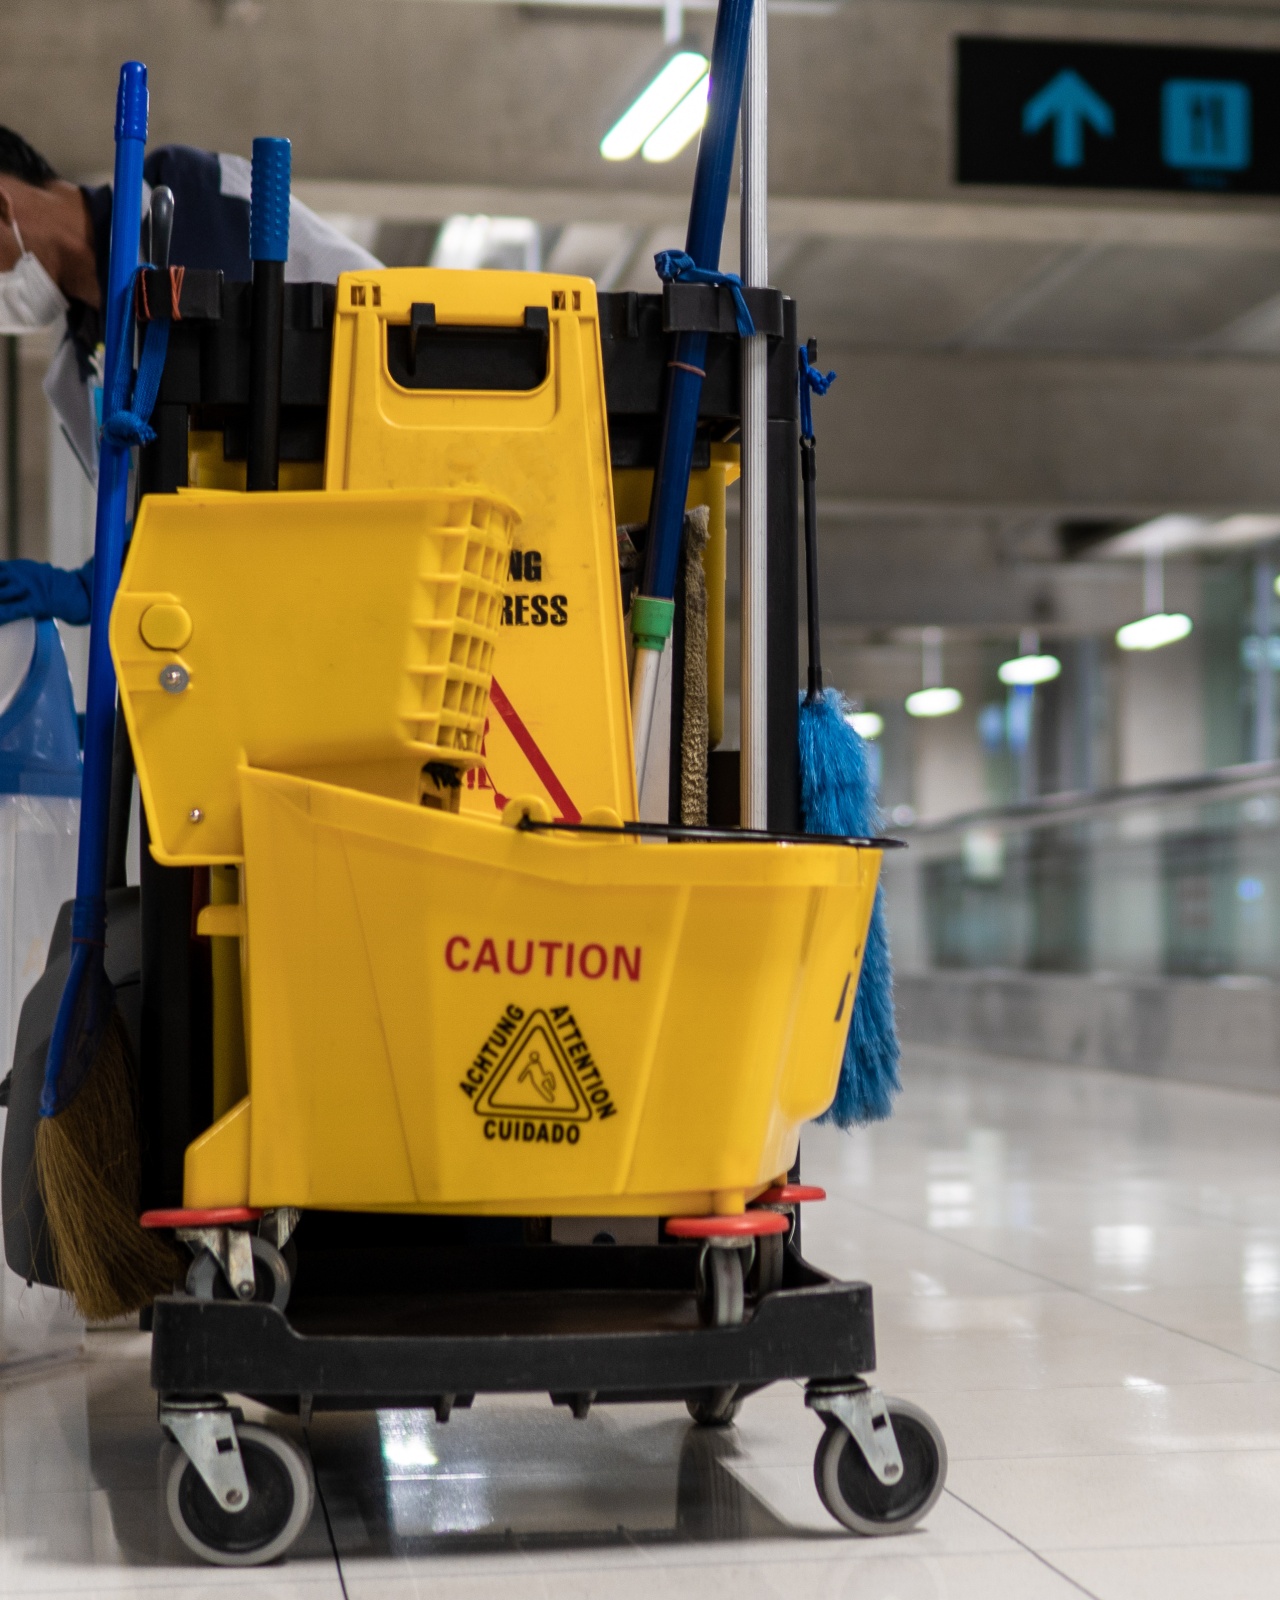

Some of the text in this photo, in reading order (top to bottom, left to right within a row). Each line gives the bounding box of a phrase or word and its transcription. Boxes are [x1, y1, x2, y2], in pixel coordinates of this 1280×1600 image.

[444, 935, 642, 982] CAUTION
[459, 1003, 525, 1099] ACHTUNG
[550, 1005, 617, 1120] ATTENTION
[483, 1119, 581, 1145] CUIDADO
